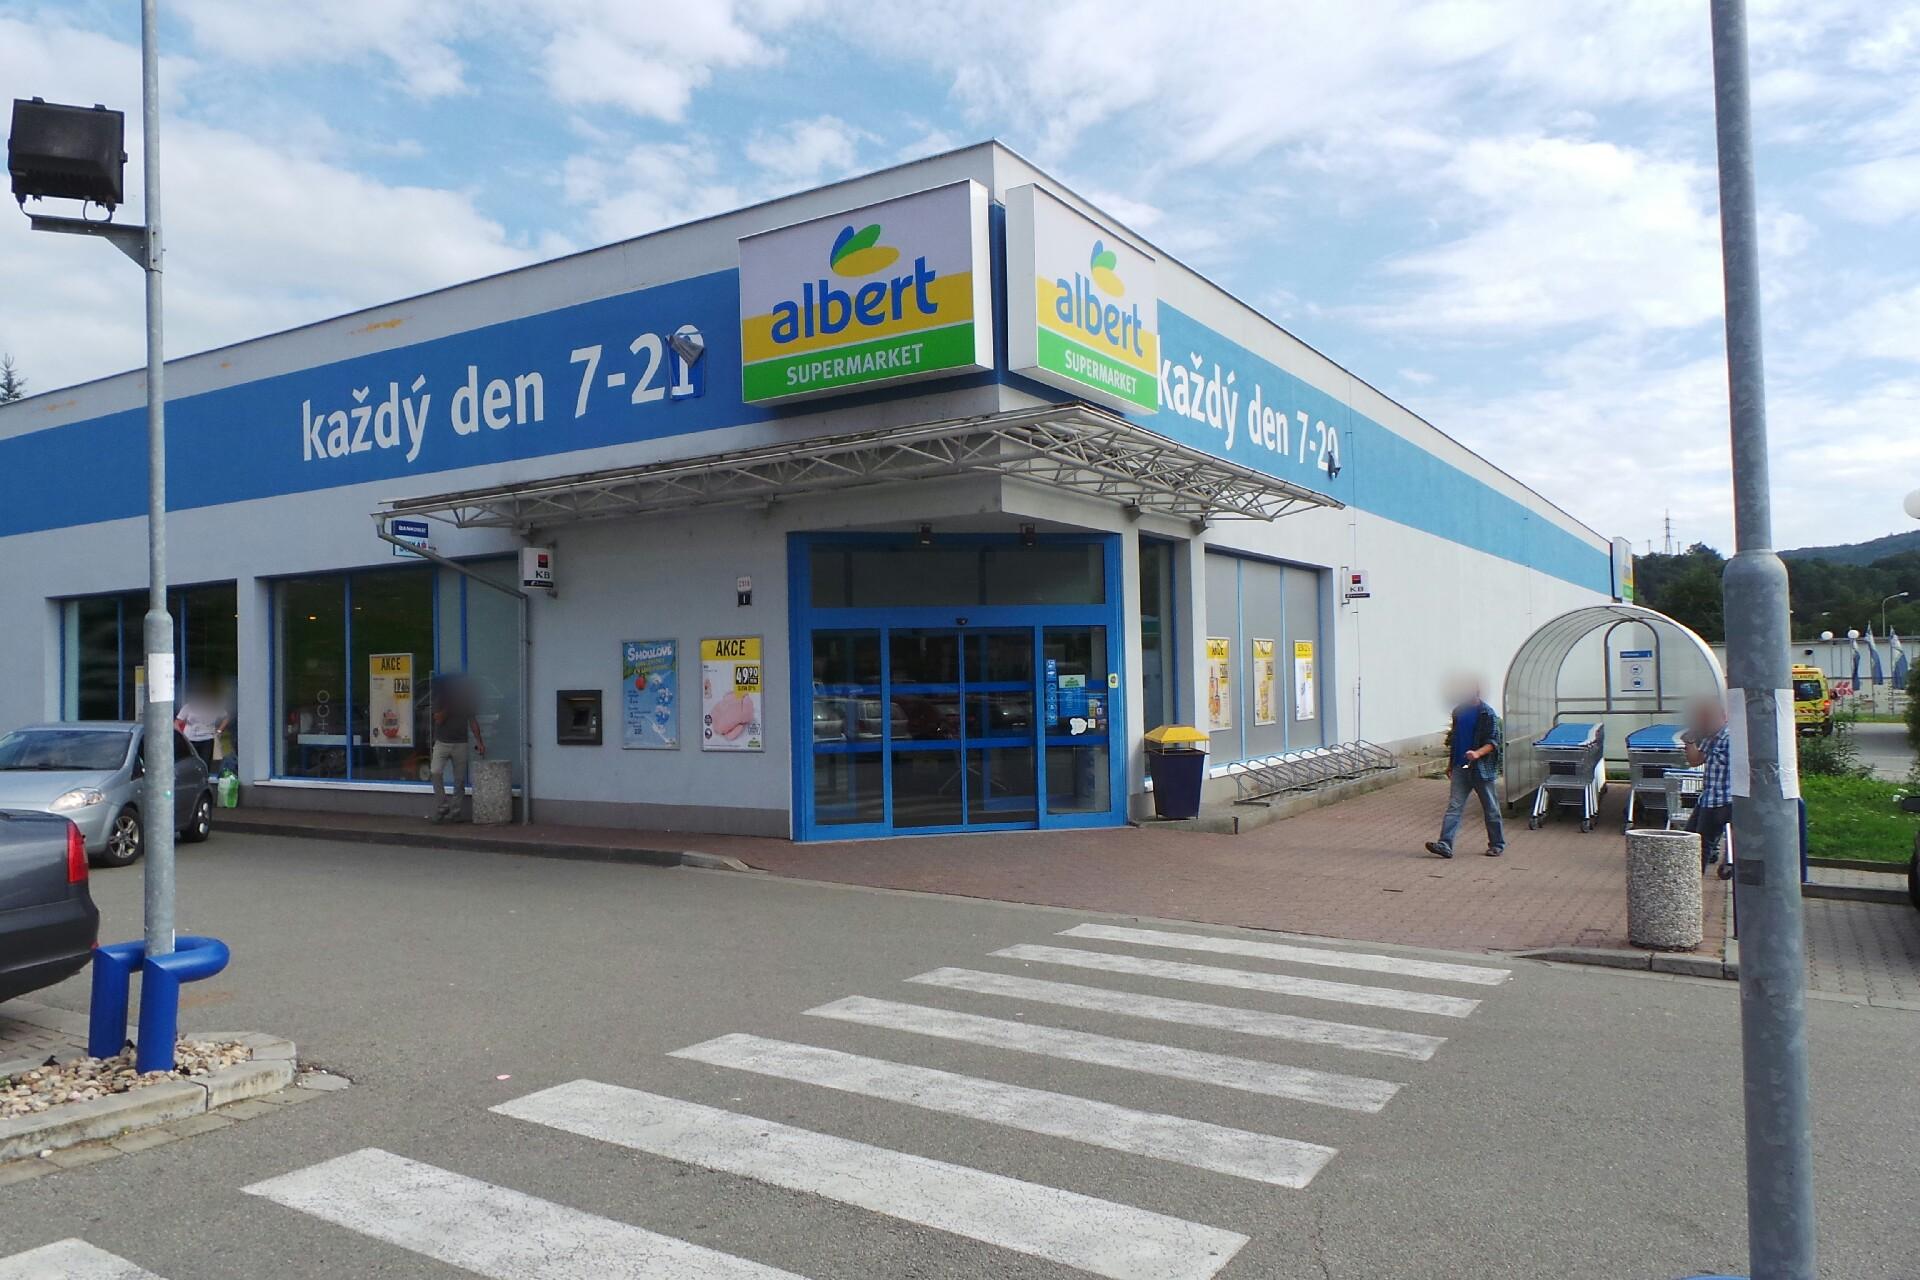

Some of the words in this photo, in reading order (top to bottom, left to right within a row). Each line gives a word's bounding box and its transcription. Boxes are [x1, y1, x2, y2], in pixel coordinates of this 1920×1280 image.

[772, 256, 939, 344] albert
[1055, 271, 1143, 358] albert
[786, 343, 924, 386] SUPERMARKET
[1064, 349, 1137, 395] SUPERMARKET
[302, 374, 431, 463] každý
[450, 365, 544, 436] den
[1158, 351, 1239, 450] každý
[1248, 384, 1289, 456] den
[398, 525, 427, 534] BANKO
[535, 570, 550, 579] KB
[381, 657, 401, 671] AKCE
[715, 640, 746, 657] AKCE
